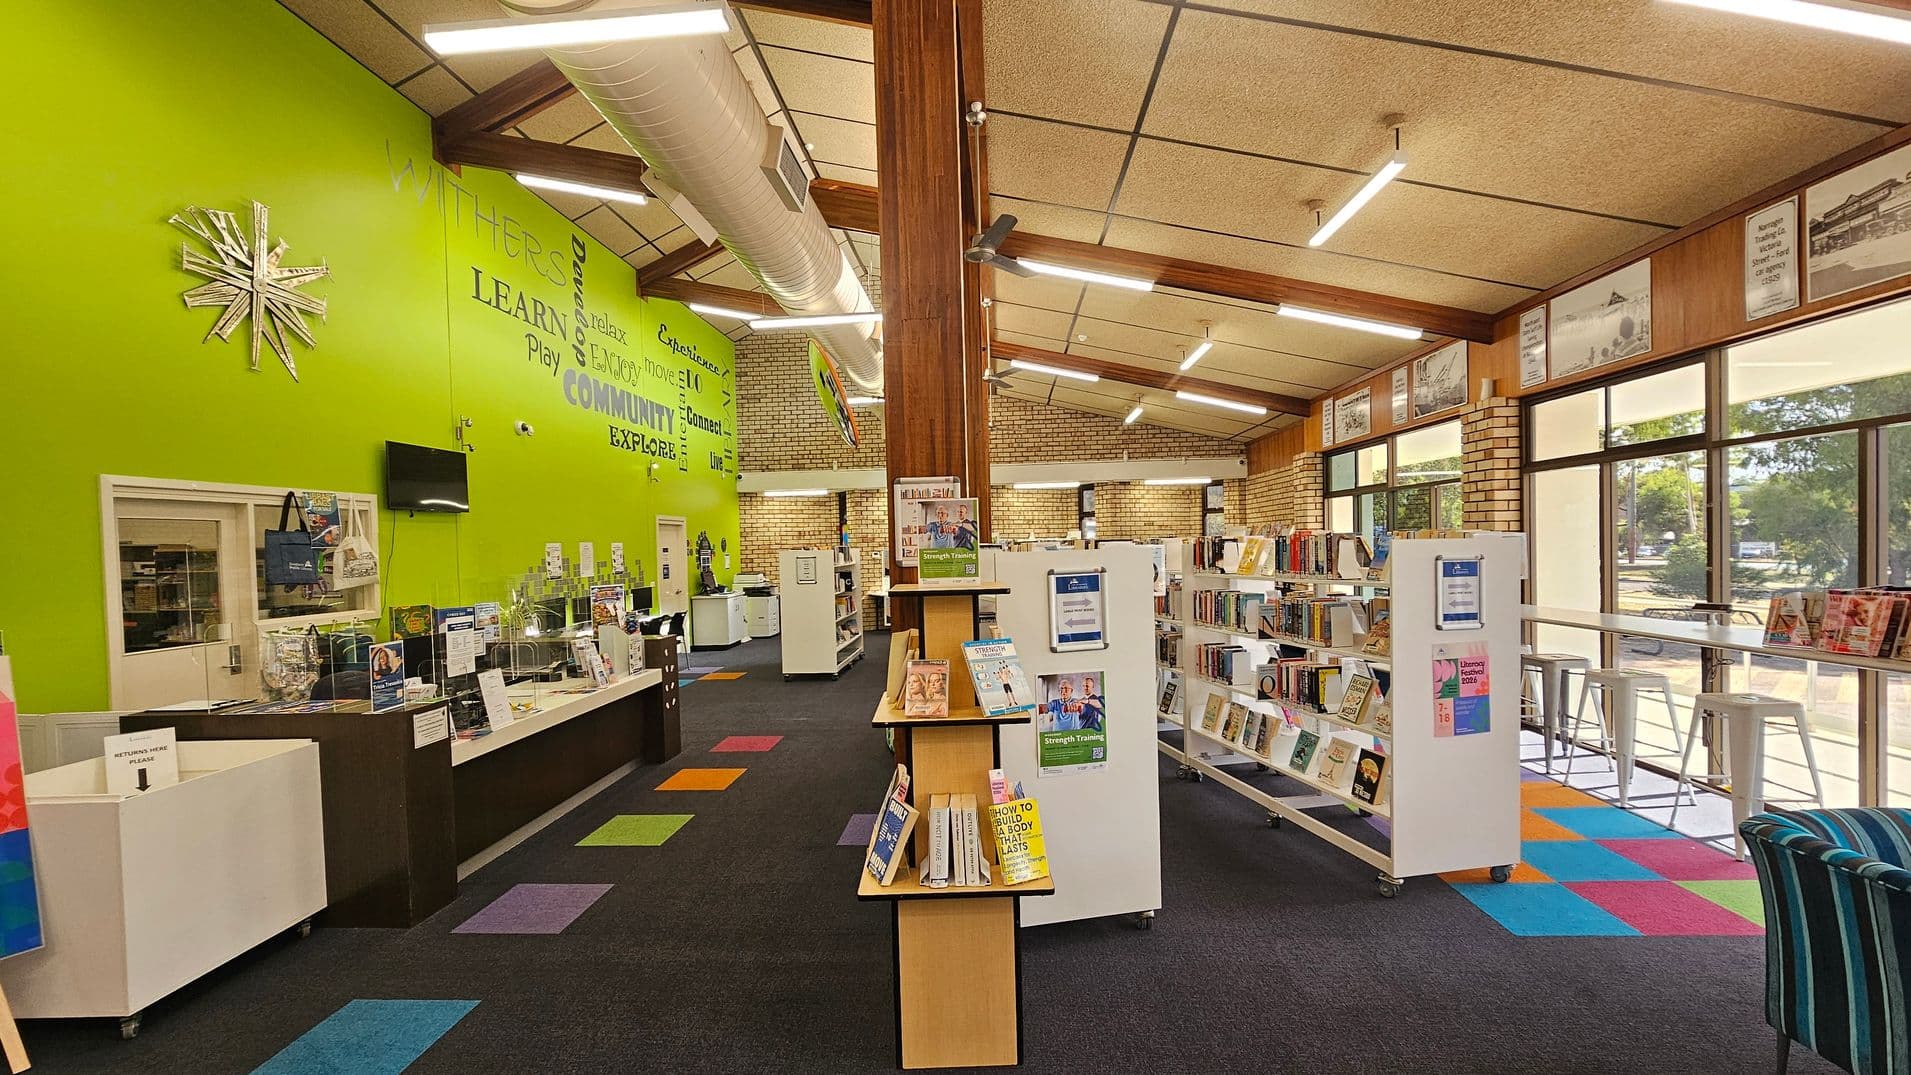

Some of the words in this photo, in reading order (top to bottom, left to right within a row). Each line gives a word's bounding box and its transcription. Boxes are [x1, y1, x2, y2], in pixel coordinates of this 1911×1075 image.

[384, 138, 567, 287] WITHERS
[1758, 217, 1784, 232] Narrogin
[1754, 231, 1777, 244] Trading
[1759, 240, 1782, 253] Victoria
[1752, 254, 1770, 268] Street
[1776, 247, 1790, 259] Ford
[1755, 268, 1764, 277] car
[1765, 260, 1786, 275] agency
[471, 265, 568, 342] LEARN
[571, 233, 590, 368] Develop
[590, 312, 628, 347] relax
[524, 332, 561, 377] Play
[657, 322, 721, 377] Experience
[589, 342, 642, 387] ENJOY
[644, 356, 675, 386] move
[686, 368, 703, 394] DO
[563, 368, 675, 435] COMMUNITY
[677, 369, 688, 473] Entertain
[686, 405, 722, 437] Connect
[608, 424, 676, 461] EXPLORE
[709, 451, 724, 473] Live
[923, 552, 950, 561] Strength
[951, 552, 977, 560] Training
[974, 645, 1007, 655] STRENGTH
[1460, 660, 1485, 668] Literacy
[1461, 667, 1485, 676] Festival
[1461, 676, 1478, 684] 2026
[1044, 734, 1075, 745] Strength
[1076, 733, 1105, 742] Training
[114, 748, 148, 758] RETURNS
[149, 745, 168, 753] HERE
[129, 756, 155, 765] PLEASE
[888, 799, 910, 822] BUILT
[995, 803, 1018, 818] HOW
[1020, 802, 1033, 812] TO
[997, 814, 1022, 827] BUILD
[999, 827, 1005, 837] A
[1007, 820, 1033, 834] BODY
[1000, 832, 1022, 846] THAT
[1002, 841, 1028, 855] LASTS
